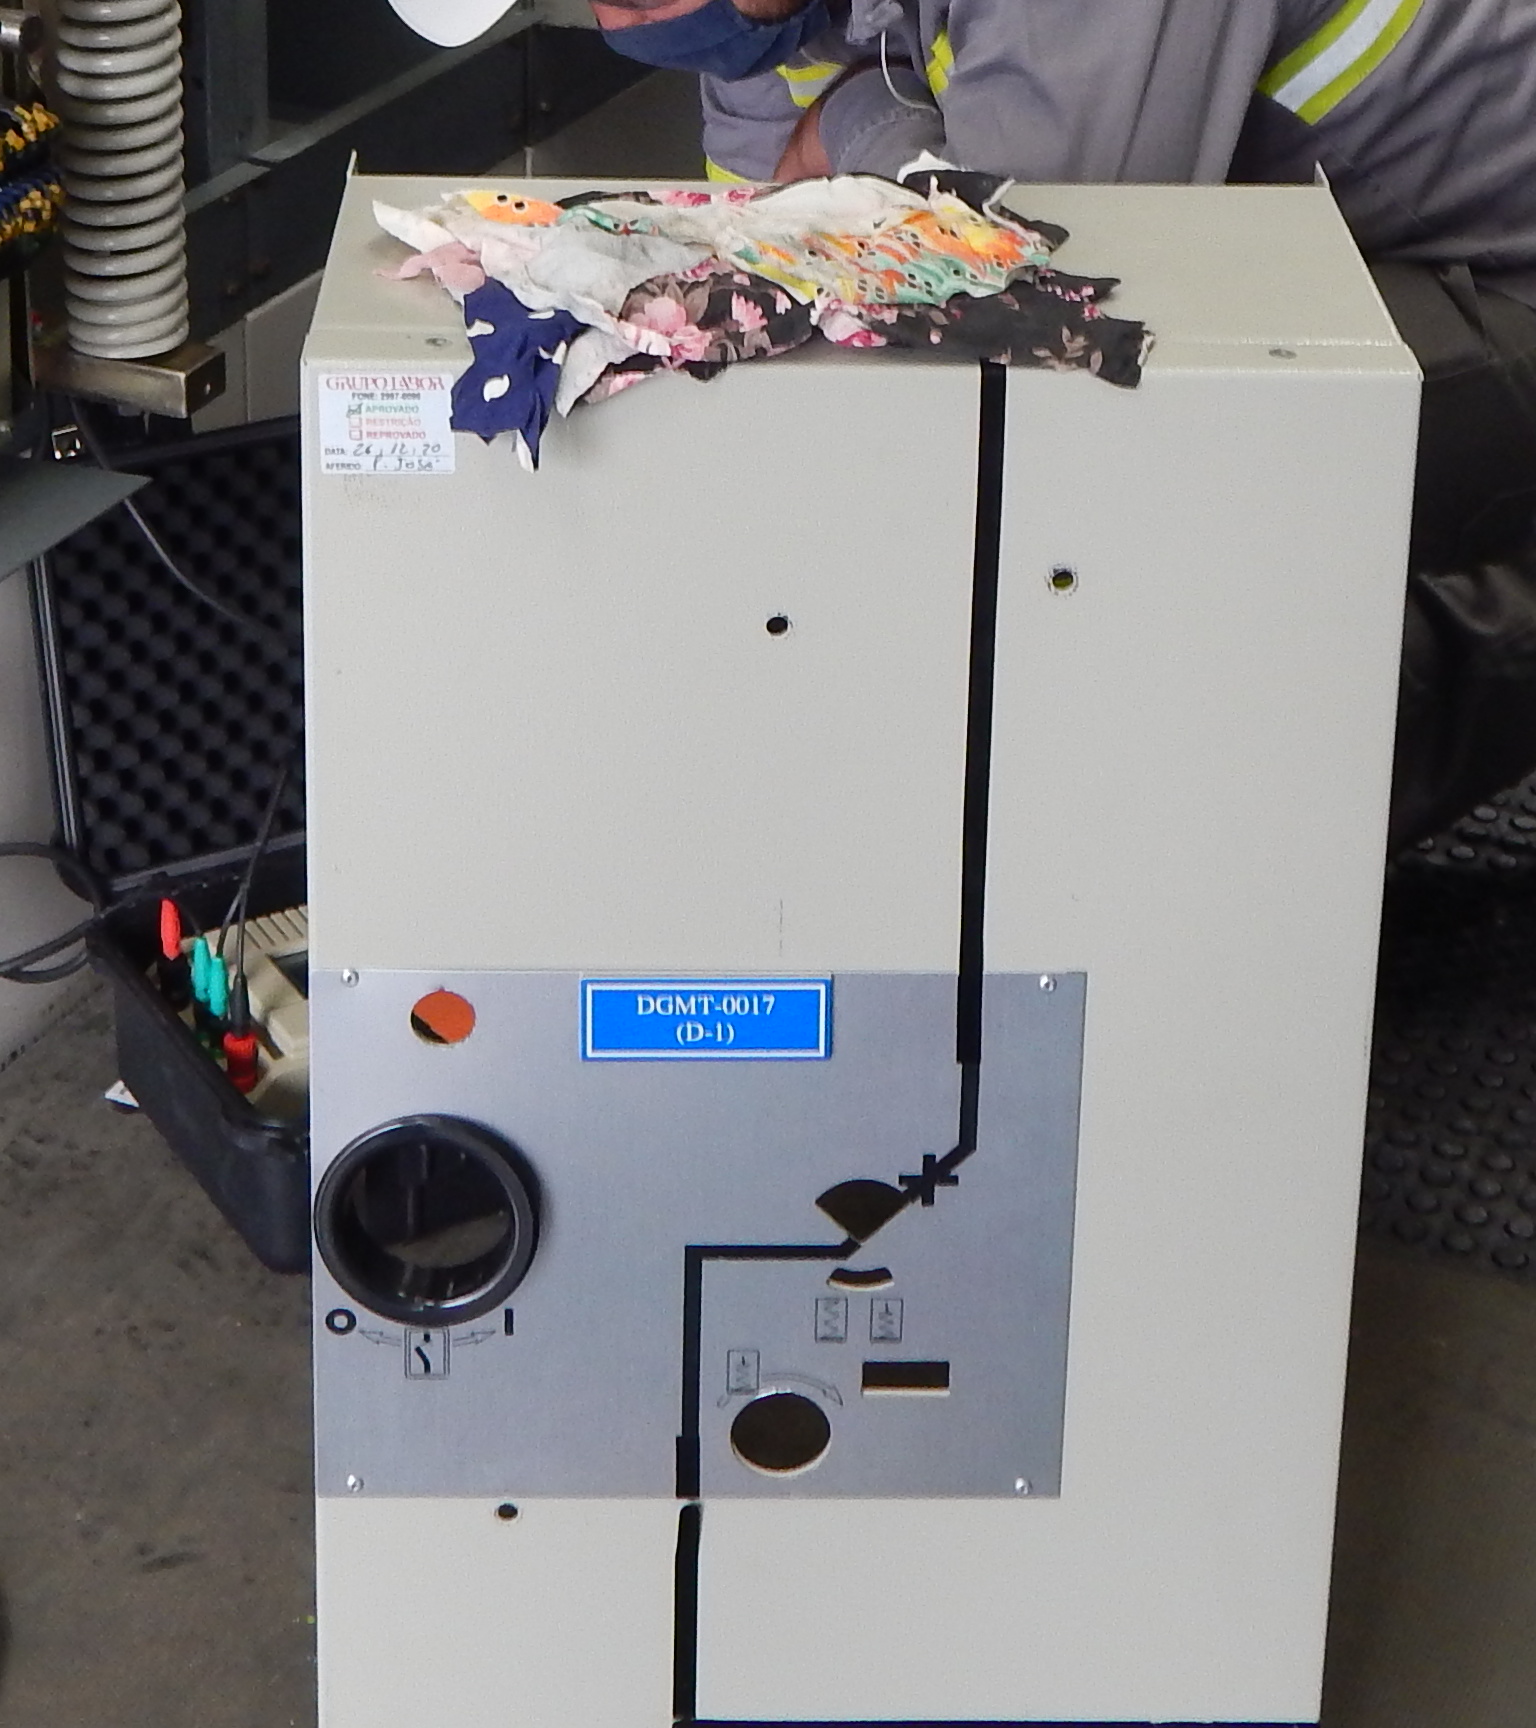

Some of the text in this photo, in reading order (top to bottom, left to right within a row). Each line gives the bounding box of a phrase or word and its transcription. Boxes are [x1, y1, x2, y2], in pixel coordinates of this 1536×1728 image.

[326, 376, 445, 391] GRUPO LABOR
[366, 405, 420, 413] APROVADO
[366, 431, 426, 439] REPROVADO
[636, 993, 776, 1016] DGMT-0017
[675, 1021, 735, 1046] (D-1)
